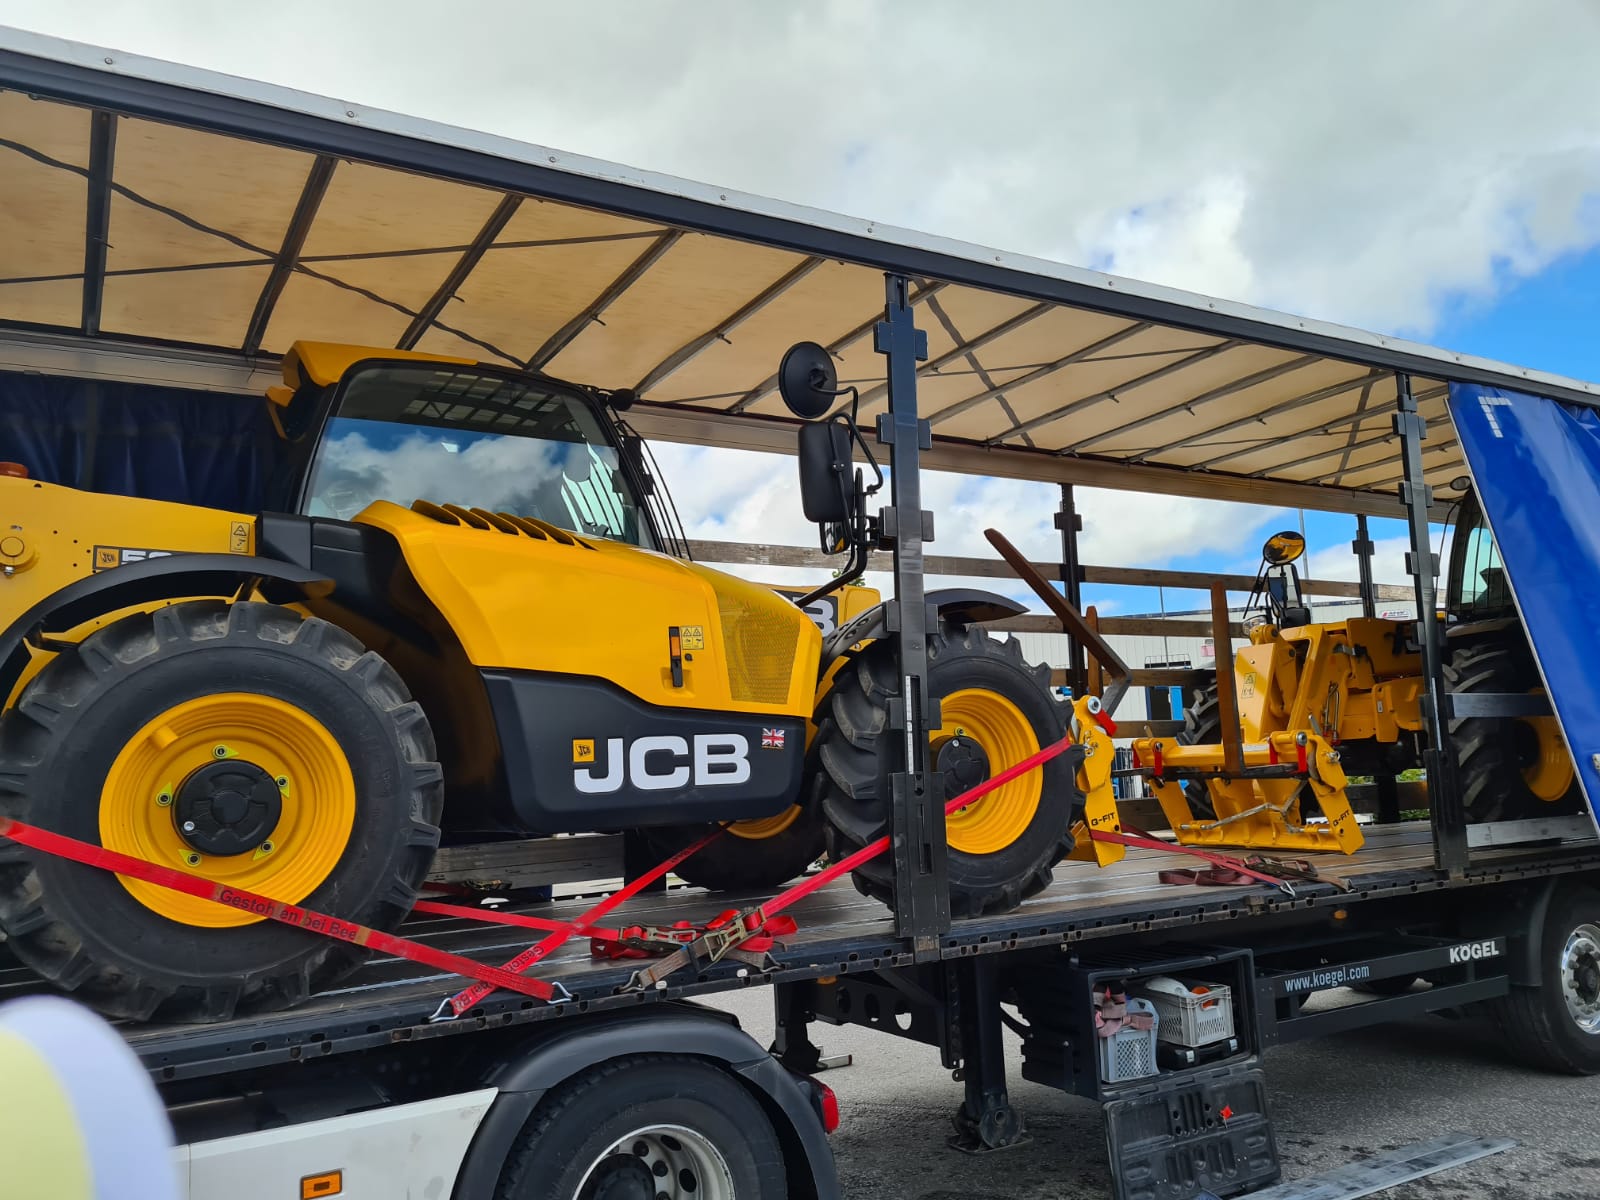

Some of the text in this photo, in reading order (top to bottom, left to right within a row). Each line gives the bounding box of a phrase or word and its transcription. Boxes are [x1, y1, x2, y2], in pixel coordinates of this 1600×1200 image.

[574, 733, 751, 793] JCB
[220, 888, 299, 922] Gestohen
[1449, 940, 1500, 964] KÖGEL
[1285, 965, 1370, 993] www.koegel.com
